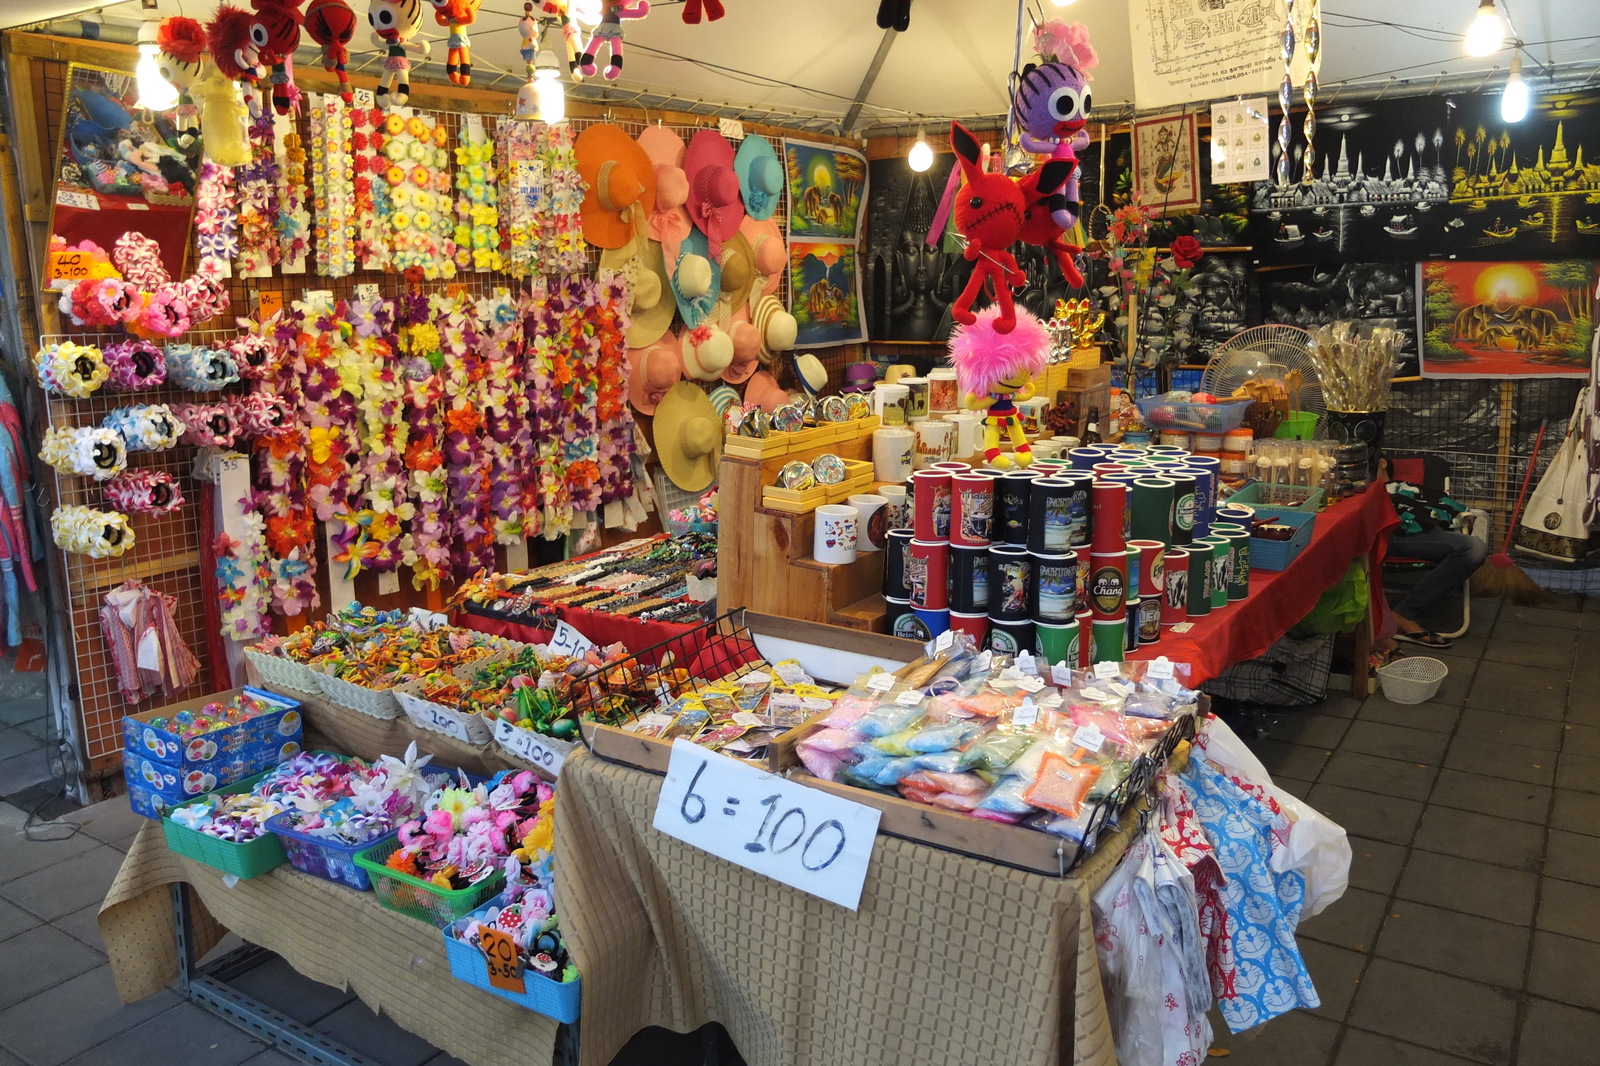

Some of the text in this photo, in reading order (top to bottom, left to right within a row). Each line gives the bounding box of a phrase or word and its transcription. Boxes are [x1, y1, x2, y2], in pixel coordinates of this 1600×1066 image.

[358, 90, 370, 104] 25
[57, 254, 82, 267] 40
[223, 460, 238, 471] 35
[1093, 585, 1123, 597] Chang
[1139, 610, 1160, 622] LEO
[680, 758, 847, 872] 6 = 100
[482, 931, 513, 963] 20
